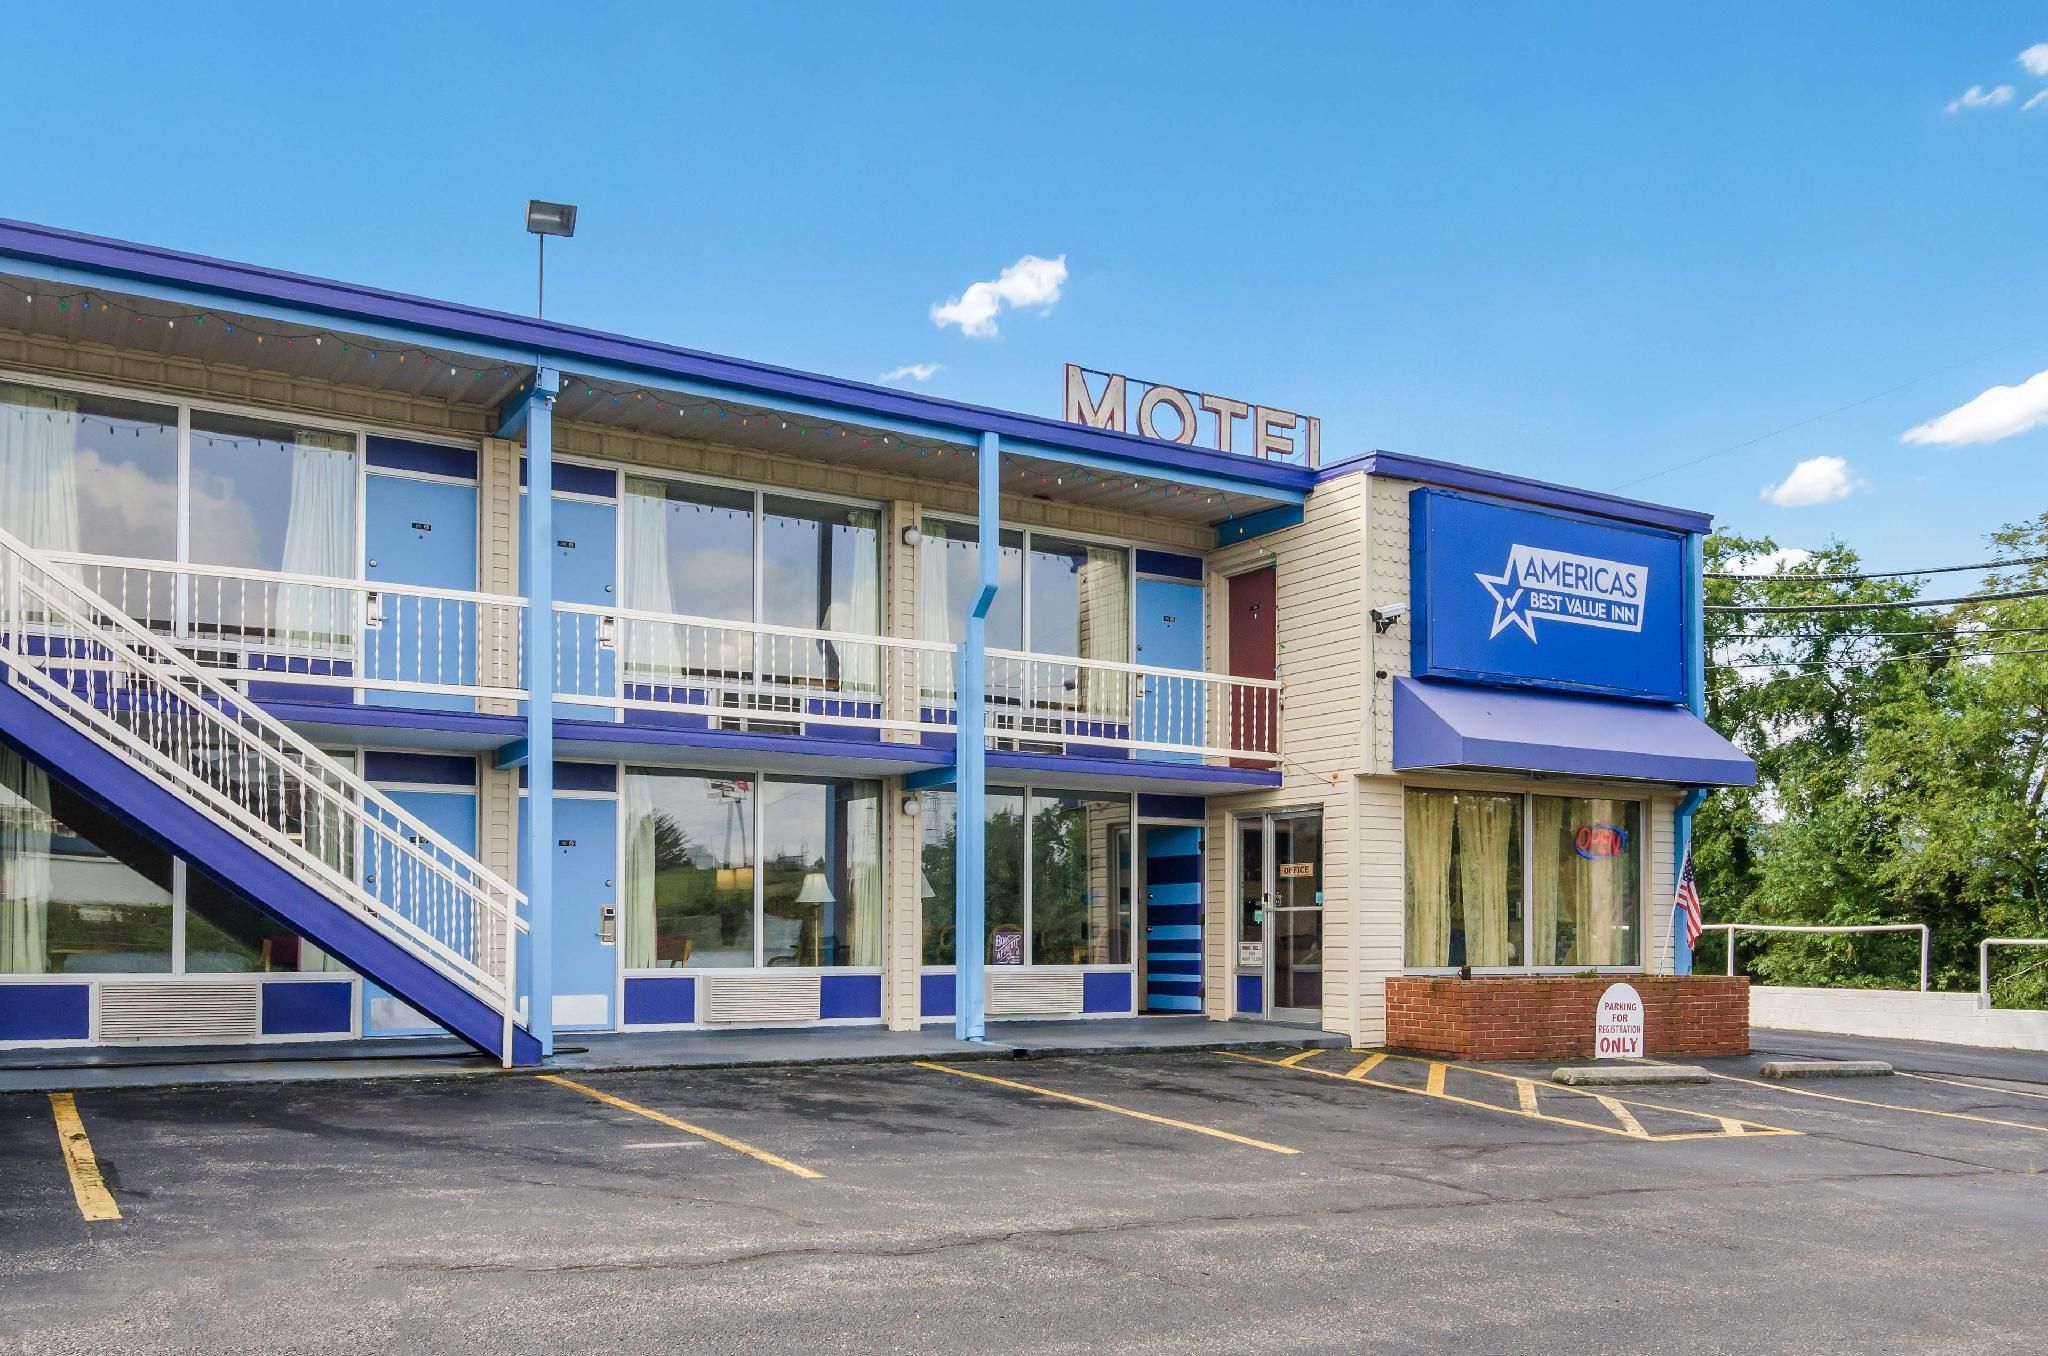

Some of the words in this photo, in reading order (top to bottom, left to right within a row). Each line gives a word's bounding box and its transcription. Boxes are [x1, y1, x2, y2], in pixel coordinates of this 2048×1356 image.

[1523, 556, 1638, 599] AMERICAS
[1530, 591, 1563, 612] BEST
[1565, 597, 1607, 618] VALUE
[1611, 604, 1635, 623] INN
[1575, 825, 1622, 857] OPEN
[1283, 865, 1310, 875] OFFICE
[1604, 1002, 1637, 1011] PARKING
[1612, 1014, 1628, 1022] FOR
[1598, 1025, 1641, 1034] REGISTRATION
[1599, 1037, 1639, 1054] ONLY
